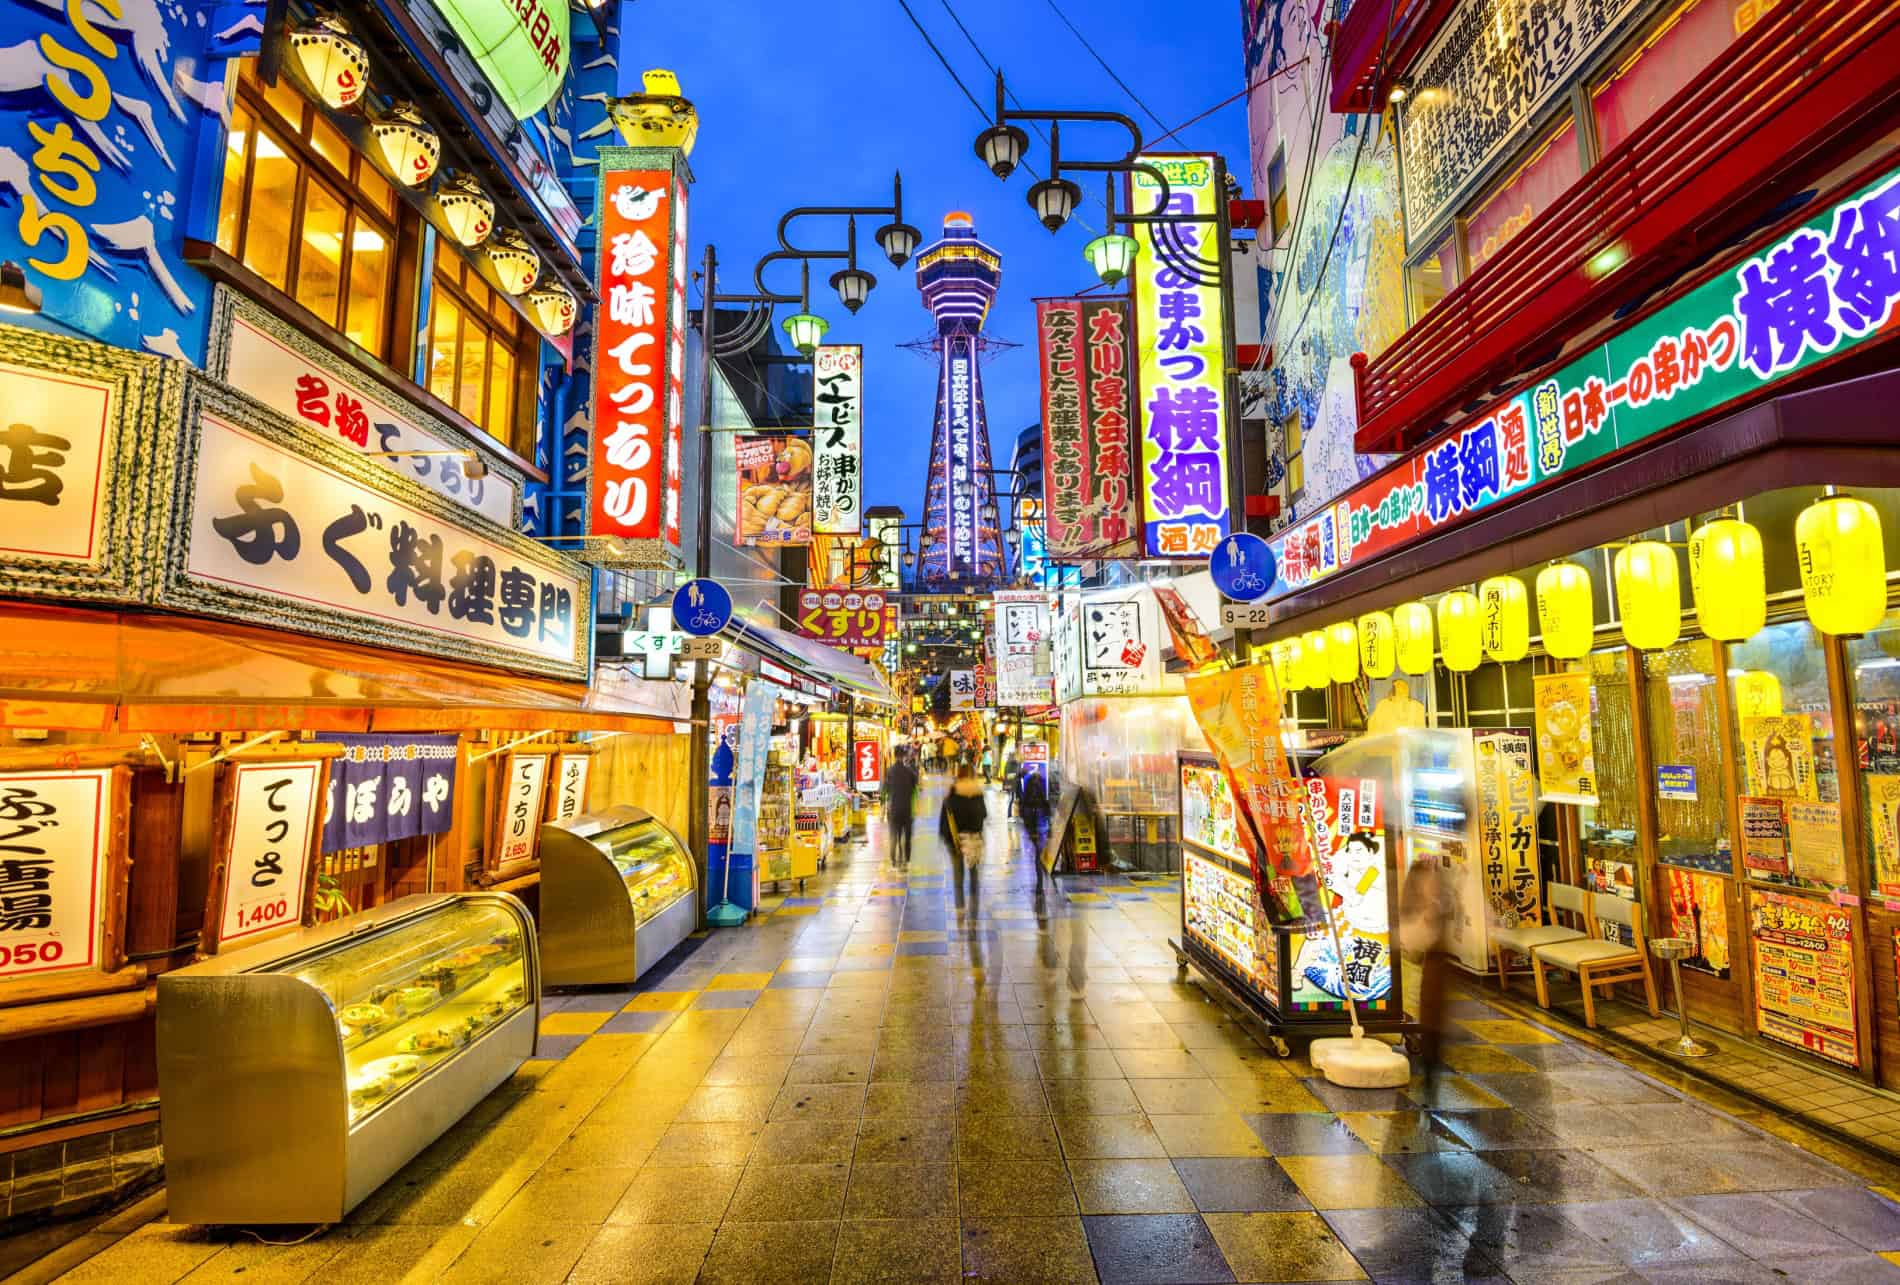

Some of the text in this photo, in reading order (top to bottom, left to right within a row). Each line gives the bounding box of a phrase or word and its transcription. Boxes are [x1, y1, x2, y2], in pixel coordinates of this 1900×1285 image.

[603, 229, 659, 526] 珍味てっちり
[1563, 321, 1735, 442] 日本一の串かつ
[1149, 387, 1222, 517] 横綱
[1501, 405, 1529, 487] 酒処
[1537, 384, 1562, 470] 新世界
[816, 454, 832, 522] お好み焼き
[833, 453, 857, 508] 串かつ
[1425, 421, 1499, 521] 横綱
[213, 463, 572, 643] ふぐ料理専門
[1160, 527, 1219, 552] 酒処
[1351, 485, 1424, 544] 日本一の串かつ
[802, 608, 880, 637] くすり
[513, 763, 533, 836] てっちり
[860, 744, 874, 780] くすり
[251, 778, 293, 888] てっさ
